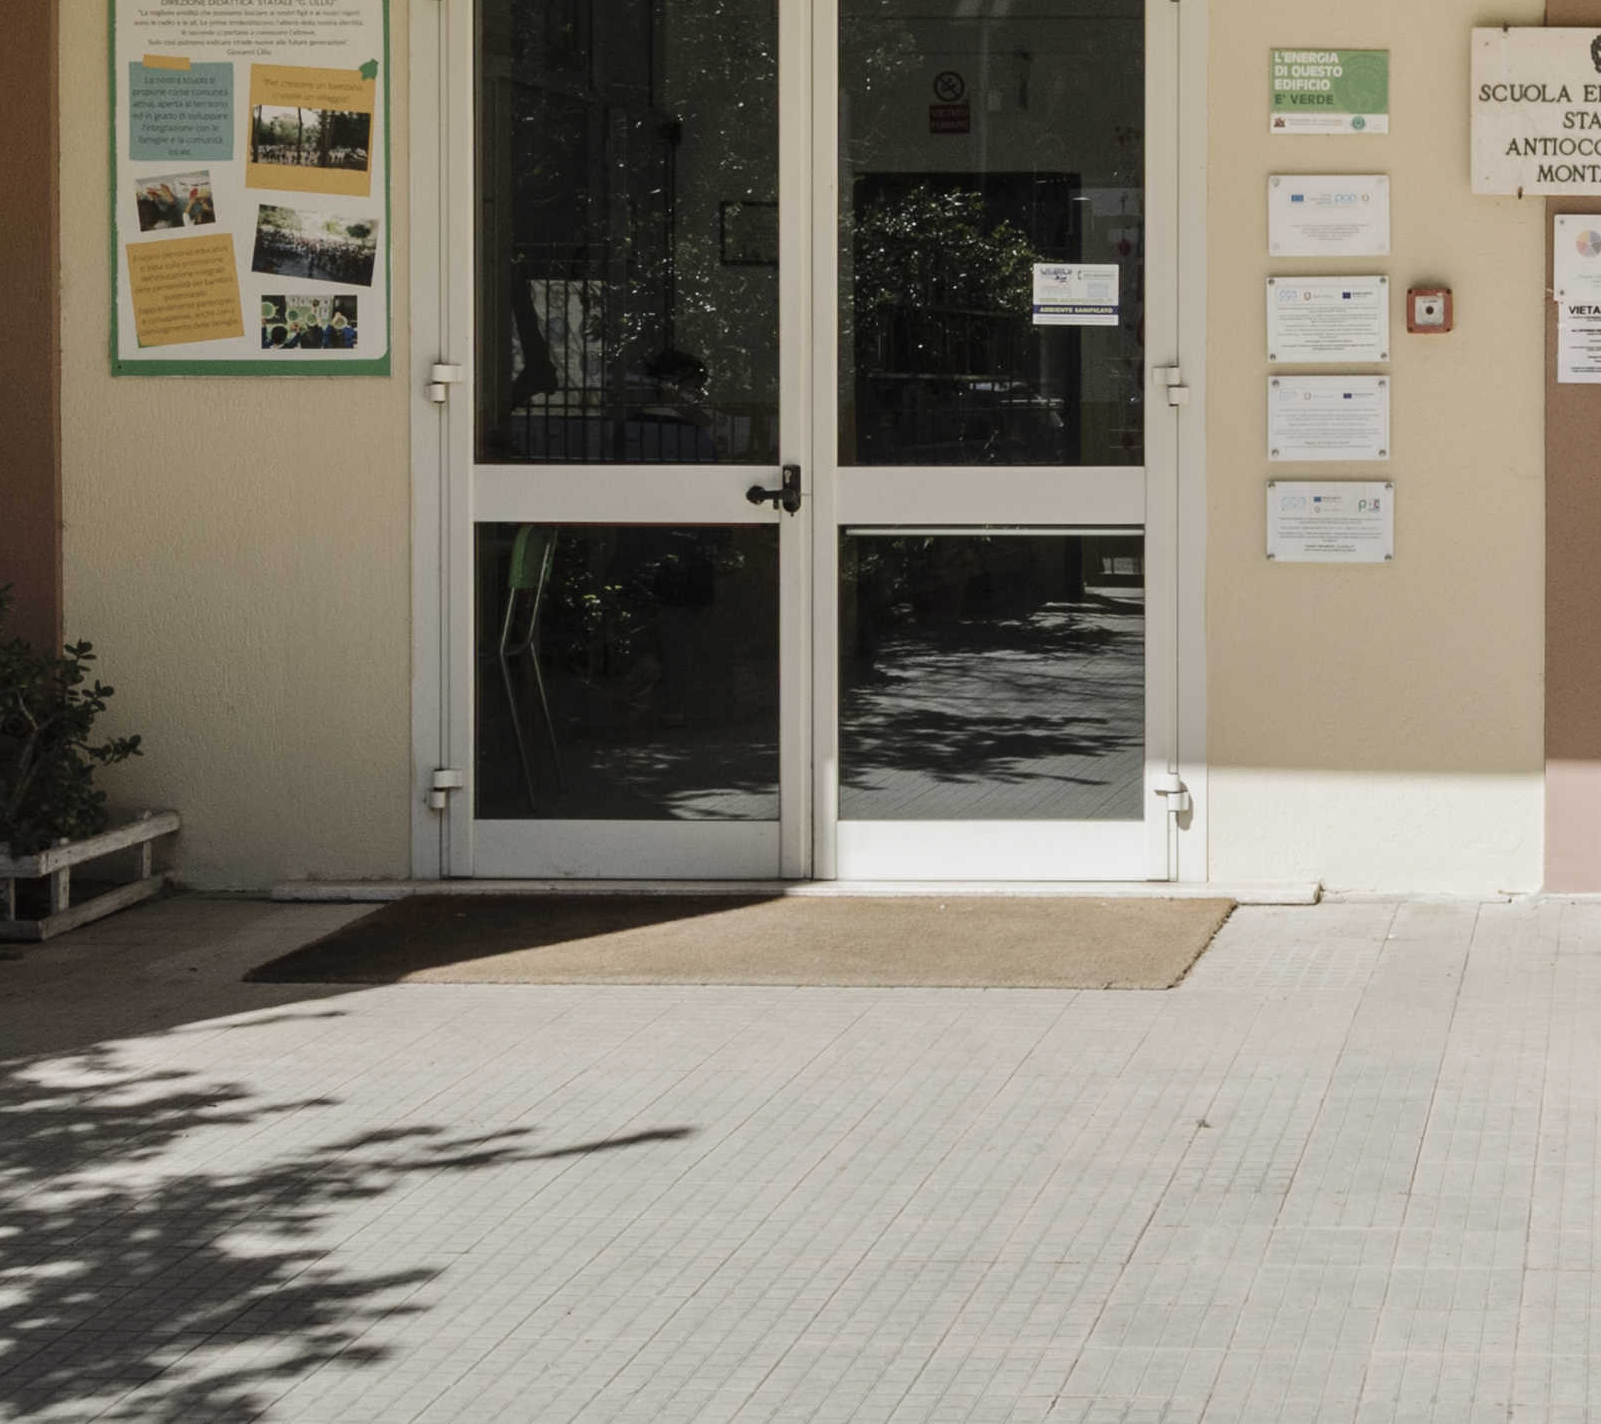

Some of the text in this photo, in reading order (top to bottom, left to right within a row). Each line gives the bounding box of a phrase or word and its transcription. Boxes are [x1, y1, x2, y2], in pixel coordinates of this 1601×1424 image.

[1274, 51, 1339, 64] L'ENERGIA
[1275, 65, 1343, 78] DI QUESTO
[1275, 79, 1330, 91] EDIFICIO
[1275, 94, 1285, 104] E'
[1479, 84, 1572, 102] SCUOLA
